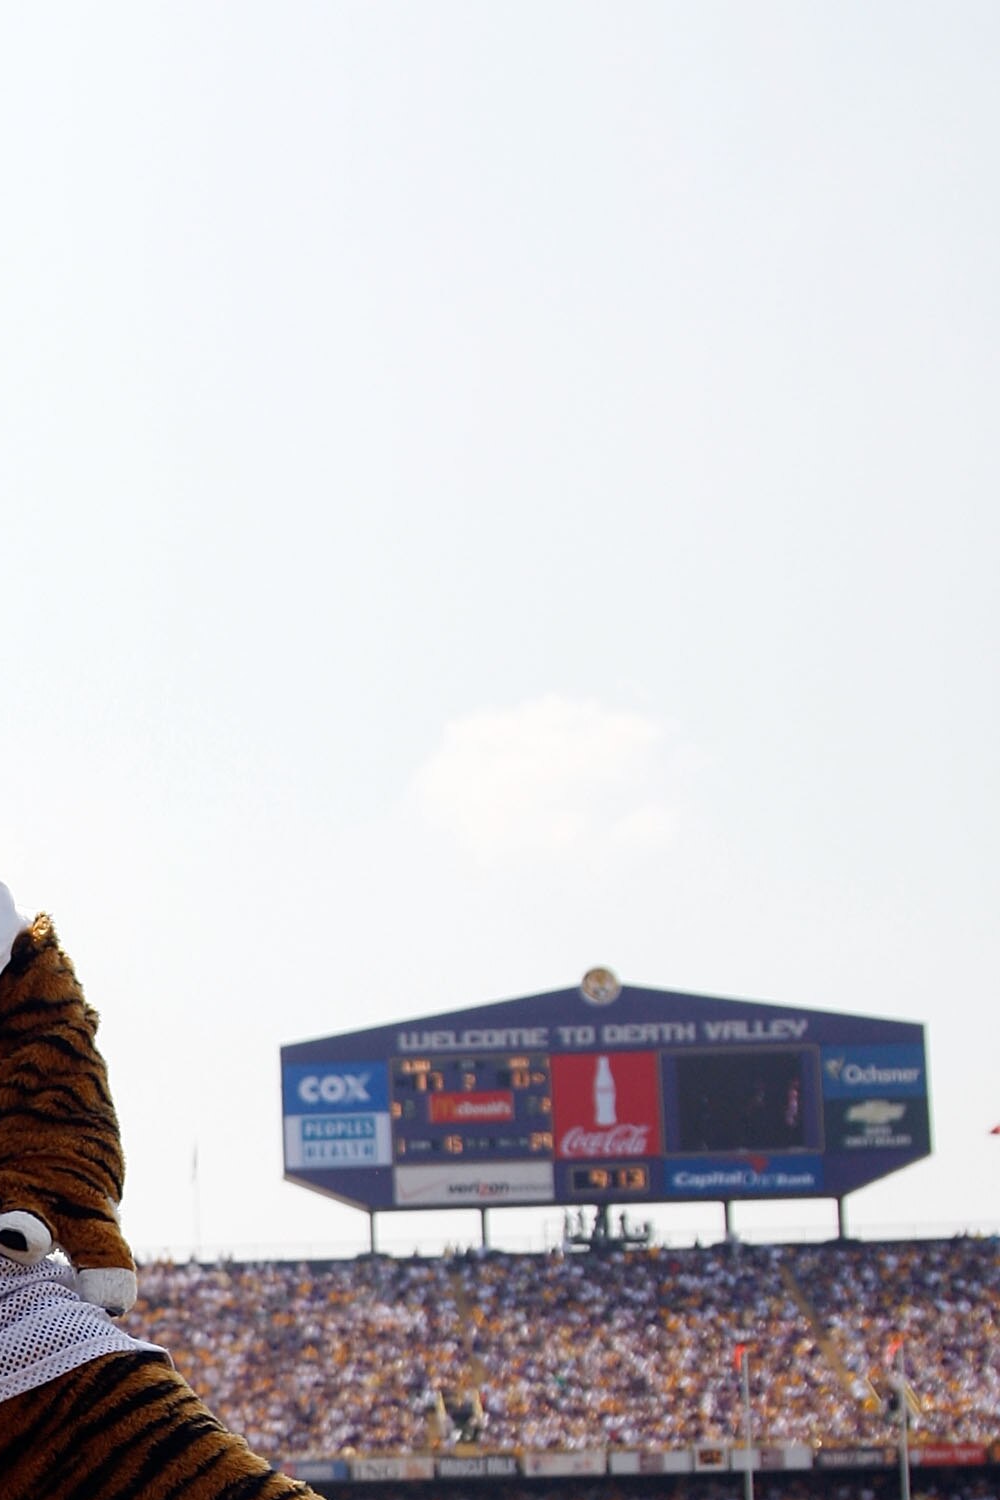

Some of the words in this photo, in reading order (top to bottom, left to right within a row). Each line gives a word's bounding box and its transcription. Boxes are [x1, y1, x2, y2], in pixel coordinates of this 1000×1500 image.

[399, 1028, 548, 1050] WELCOME
[558, 1025, 595, 1046] TO
[602, 1021, 696, 1043] DEATH
[703, 1018, 808, 1040] VALLEY
[843, 1063, 920, 1084] Ochsner
[298, 1073, 371, 1102] COX
[304, 1120, 374, 1137] PEOPLES
[561, 1124, 651, 1157] Coca-Cola
[776, 1172, 815, 1186] Bank
